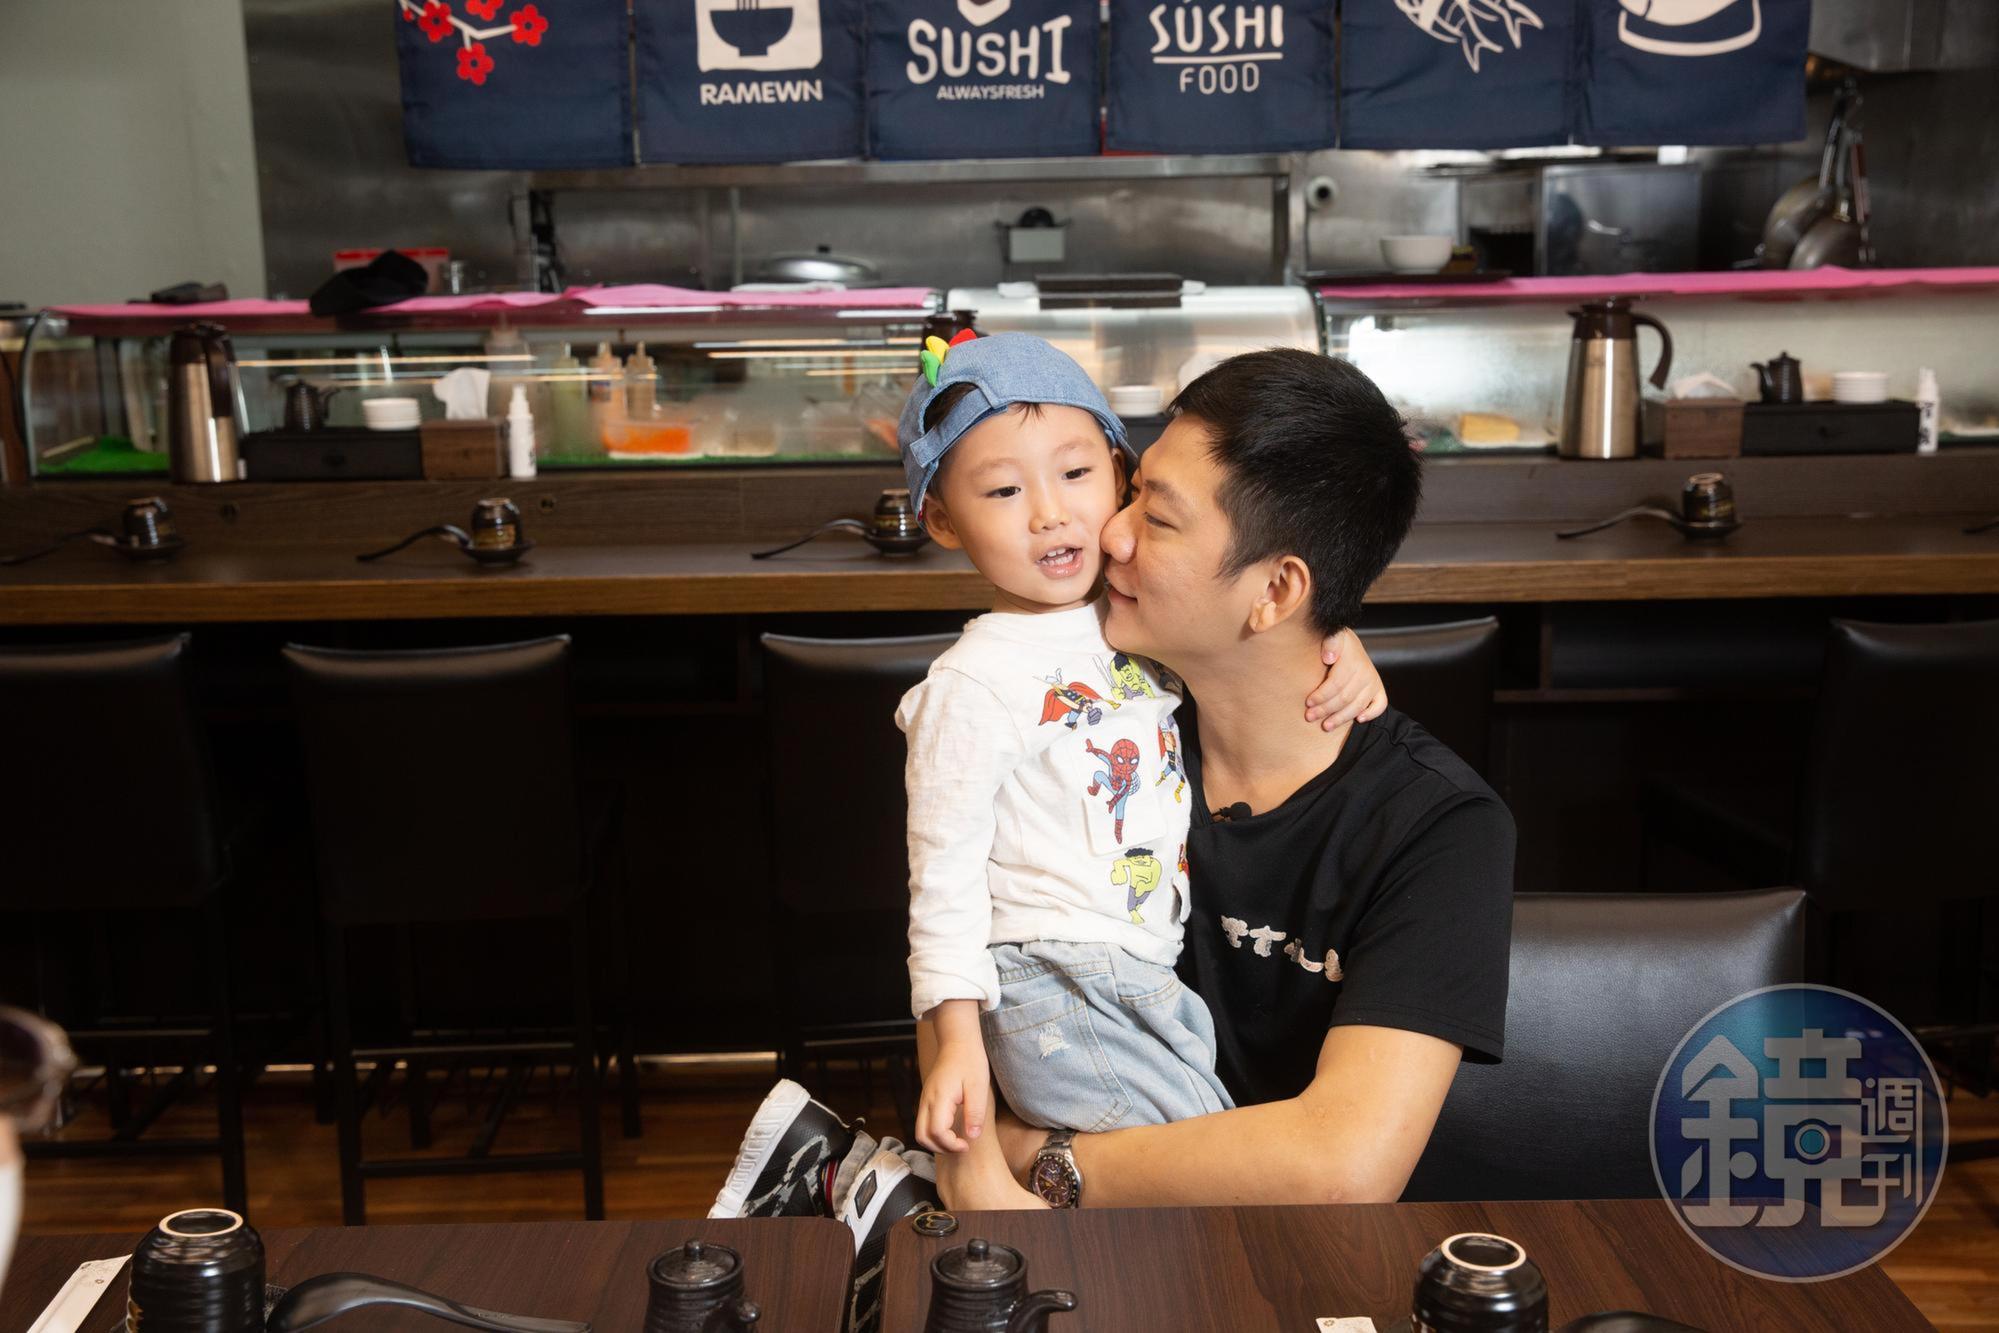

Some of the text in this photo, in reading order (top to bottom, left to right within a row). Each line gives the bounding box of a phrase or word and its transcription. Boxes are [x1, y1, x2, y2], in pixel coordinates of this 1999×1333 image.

[1149, 4, 1284, 53] SUSHI
[906, 15, 1072, 84] SUSHI
[700, 79, 823, 105] RAMEWN
[1179, 62, 1260, 95] FOOD
